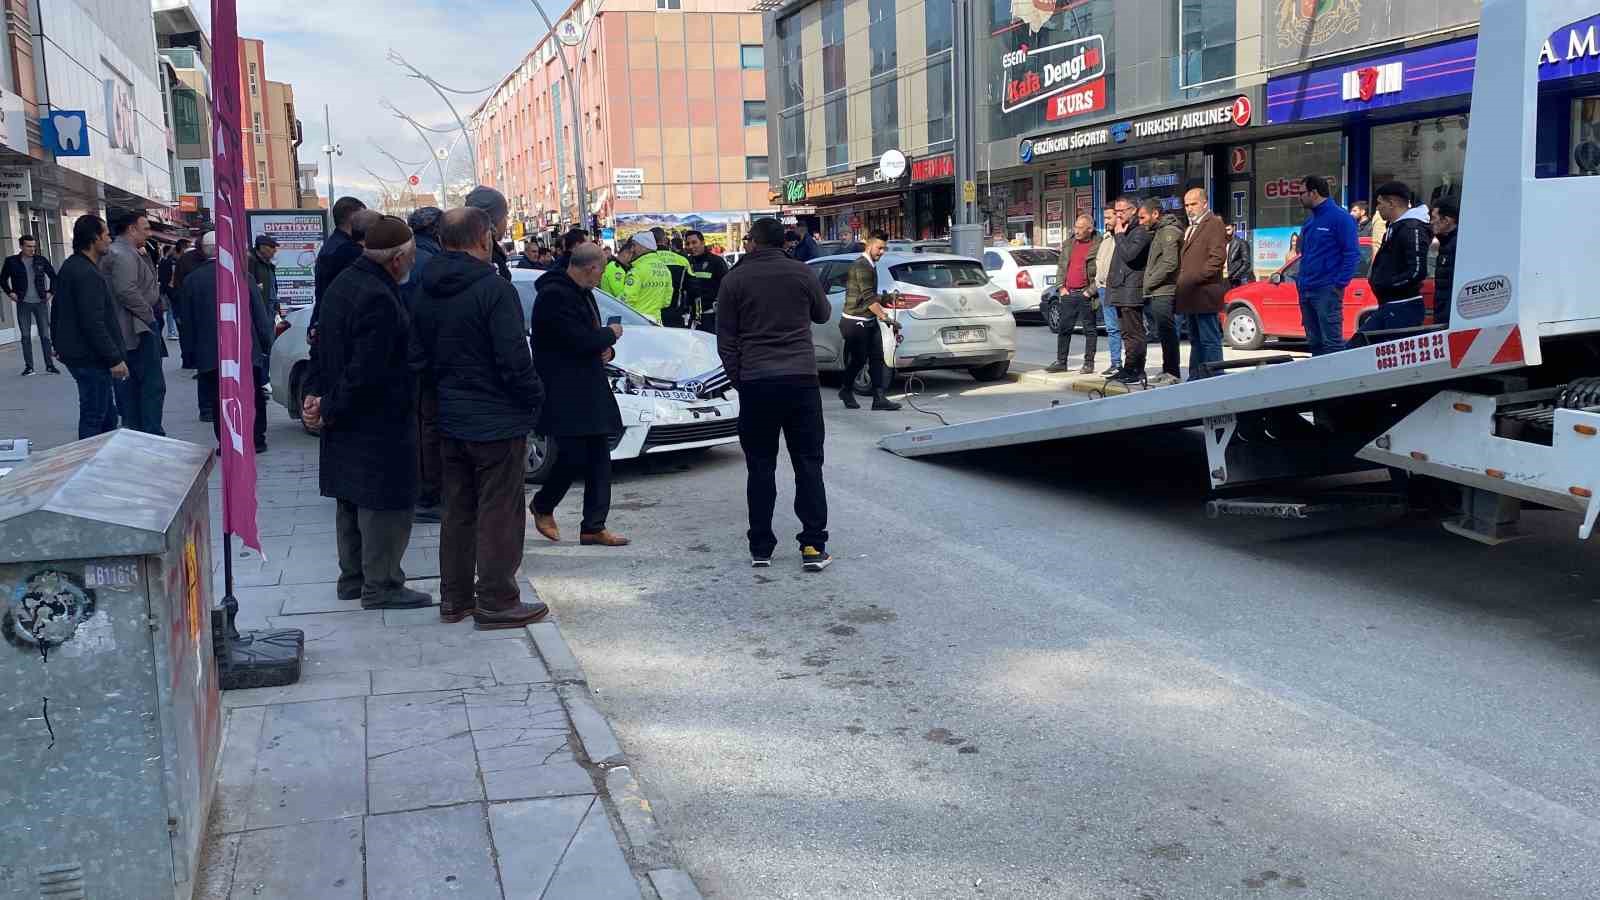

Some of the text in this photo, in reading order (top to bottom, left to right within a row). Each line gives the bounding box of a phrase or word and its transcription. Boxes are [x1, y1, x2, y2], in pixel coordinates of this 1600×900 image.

[1056, 90, 1093, 116] KURS
[1134, 117, 1178, 137] TURKISH
[1181, 106, 1232, 130] AIRLINES
